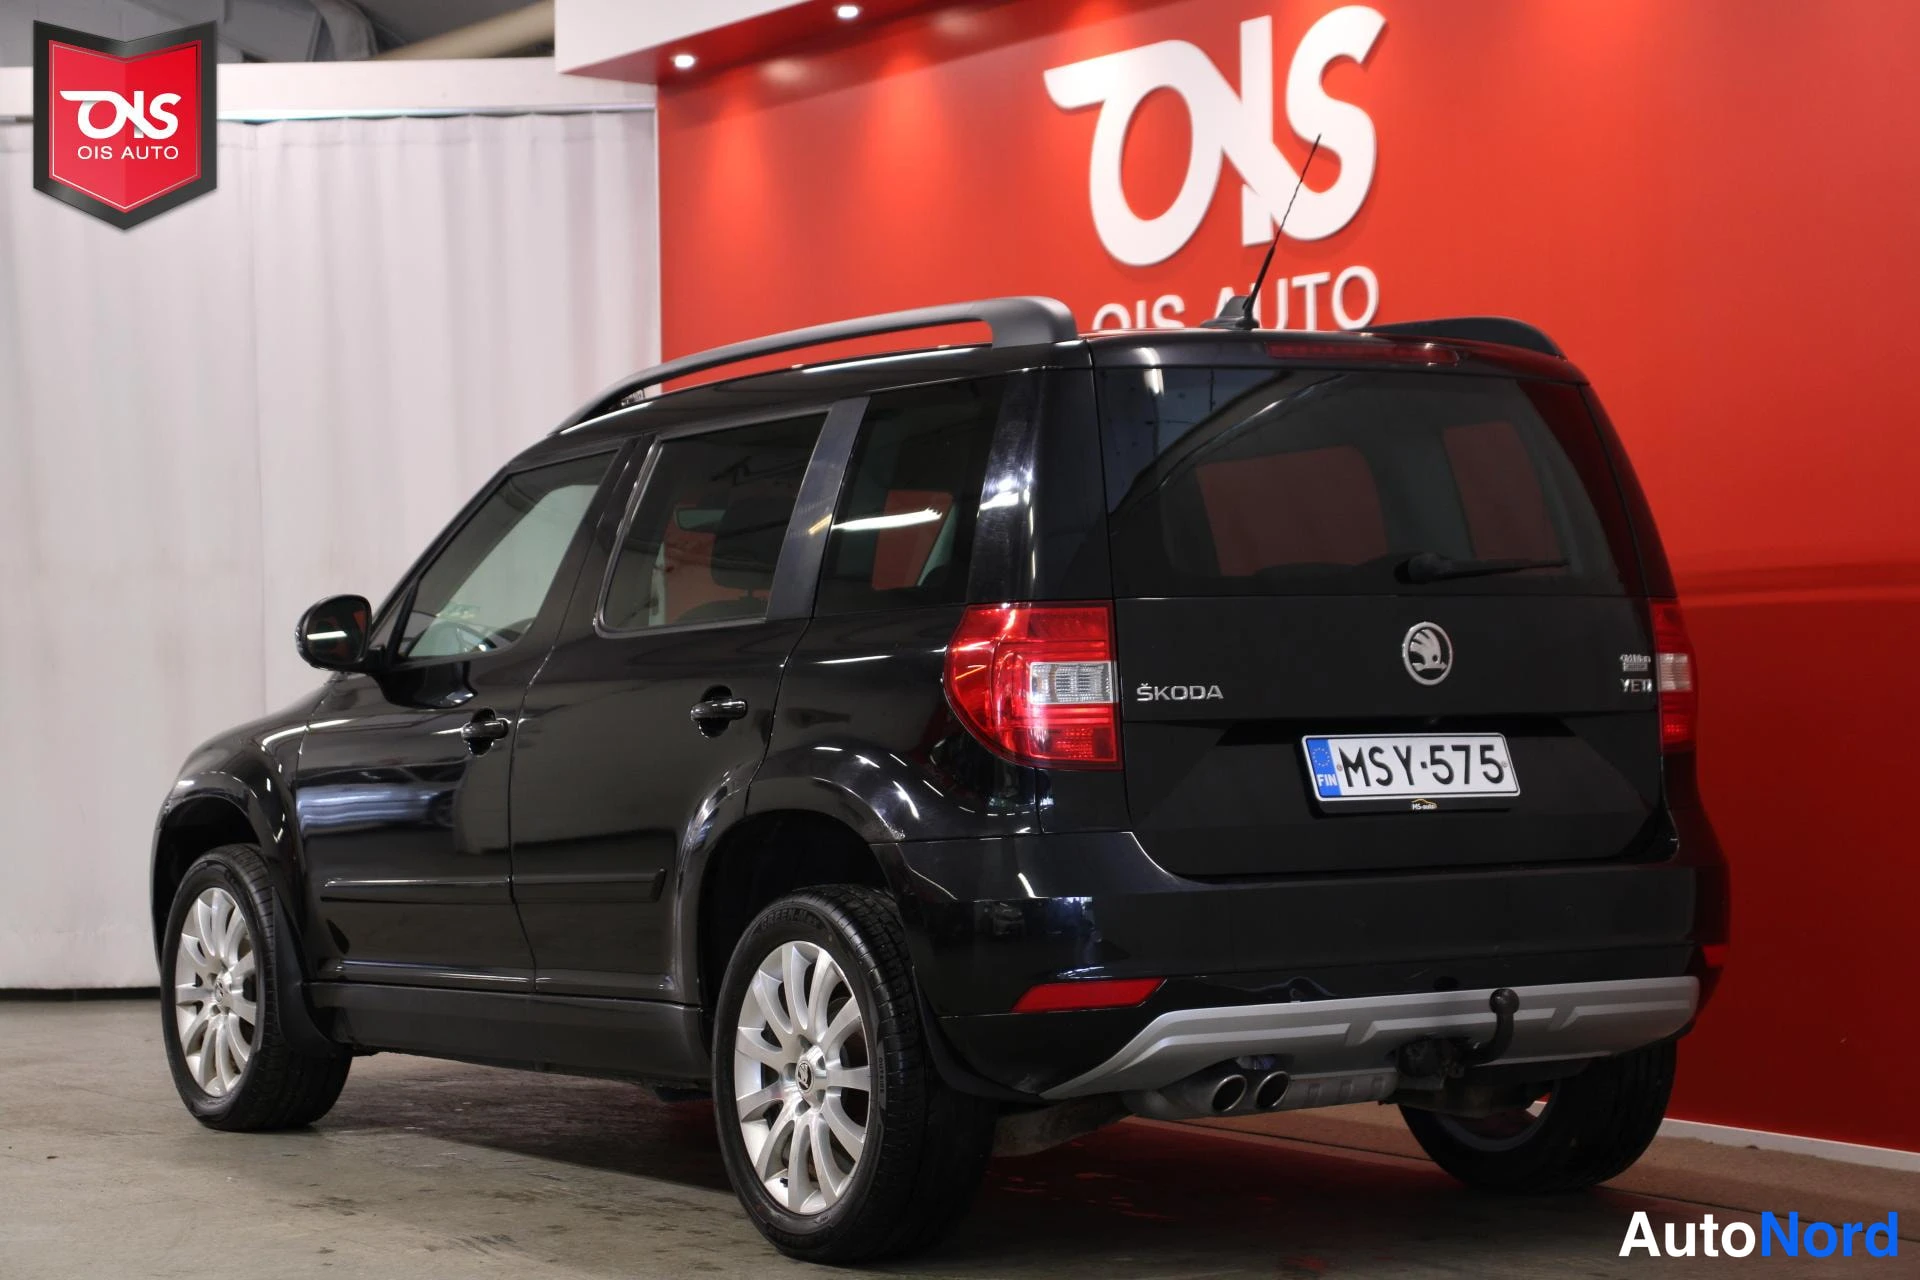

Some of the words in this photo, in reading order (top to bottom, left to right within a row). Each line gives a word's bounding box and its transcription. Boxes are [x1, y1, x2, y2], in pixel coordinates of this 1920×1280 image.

[1044, 5, 1386, 267] OIS
[1136, 682, 1225, 702] ŠKODA
[1619, 678, 1653, 693] YETI
[1317, 773, 1339, 787] FIN
